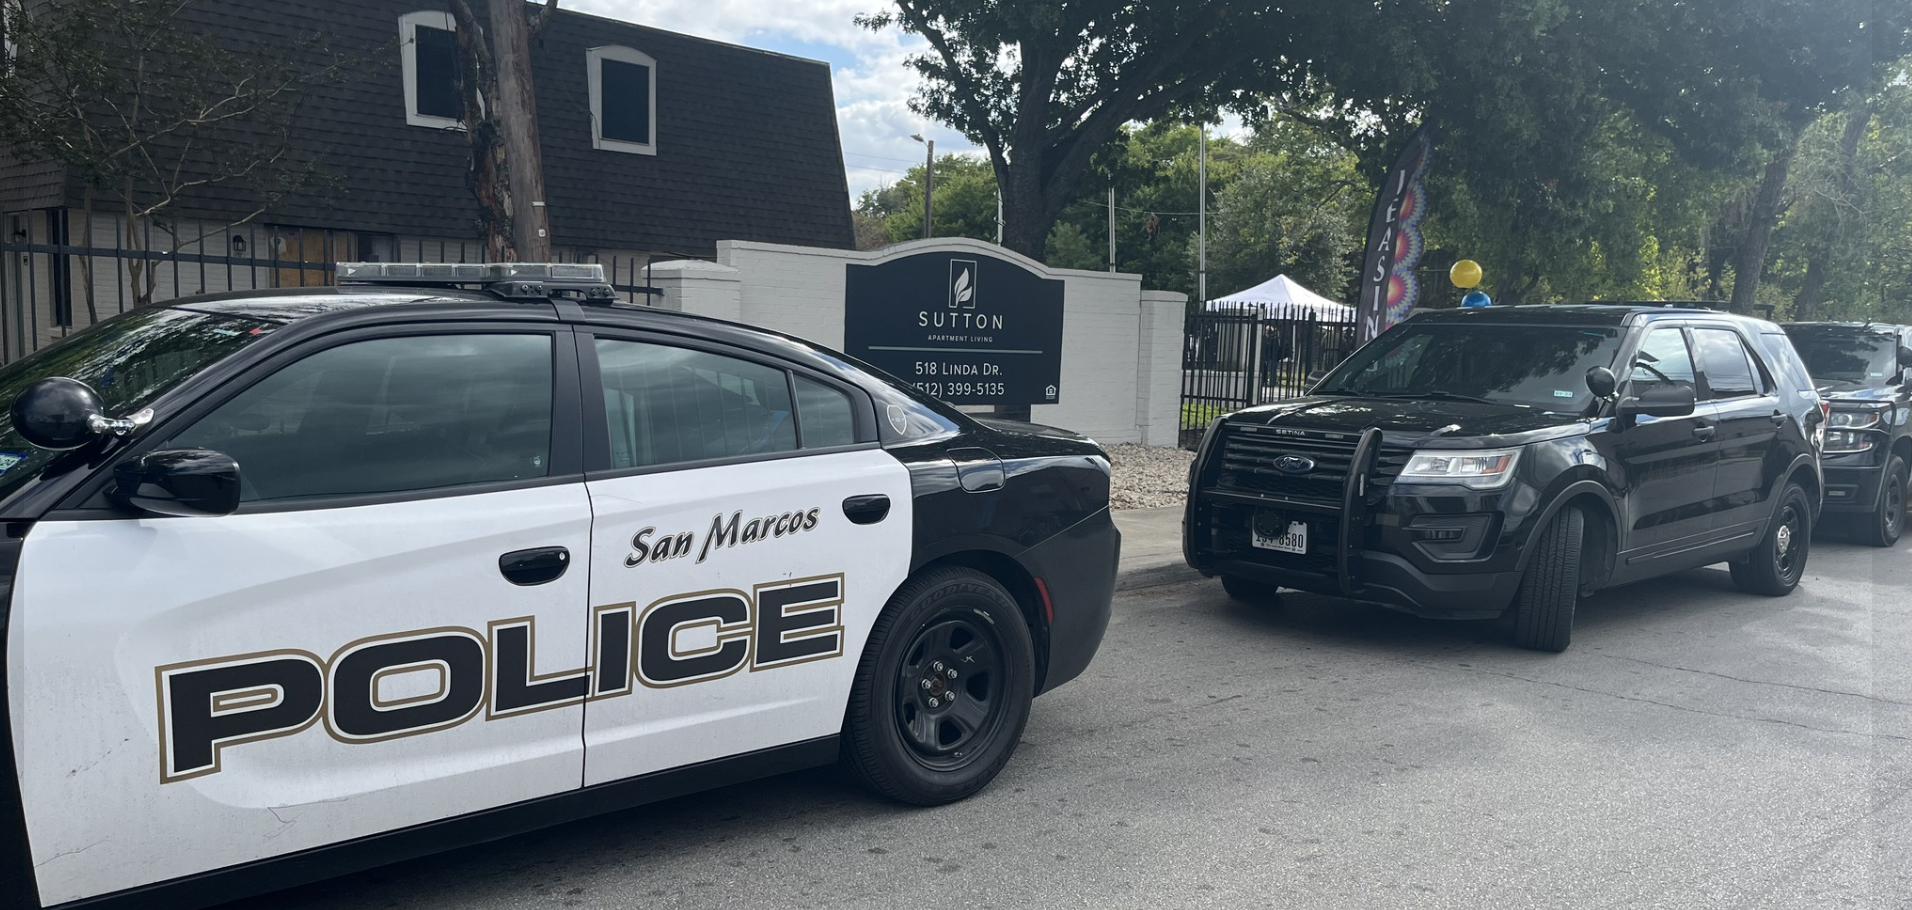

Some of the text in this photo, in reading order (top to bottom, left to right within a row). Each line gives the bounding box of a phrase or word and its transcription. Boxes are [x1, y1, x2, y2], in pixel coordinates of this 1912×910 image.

[918, 310, 1003, 330] SUTTON
[927, 334, 968, 342] APARTMENT
[915, 361, 1003, 376] 518 LINDA DR.
[947, 382, 1005, 396] 399-5135
[623, 506, 821, 569] San Marcos
[910, 582, 1010, 620] GOODYEAR
[154, 571, 846, 785] POLICE
